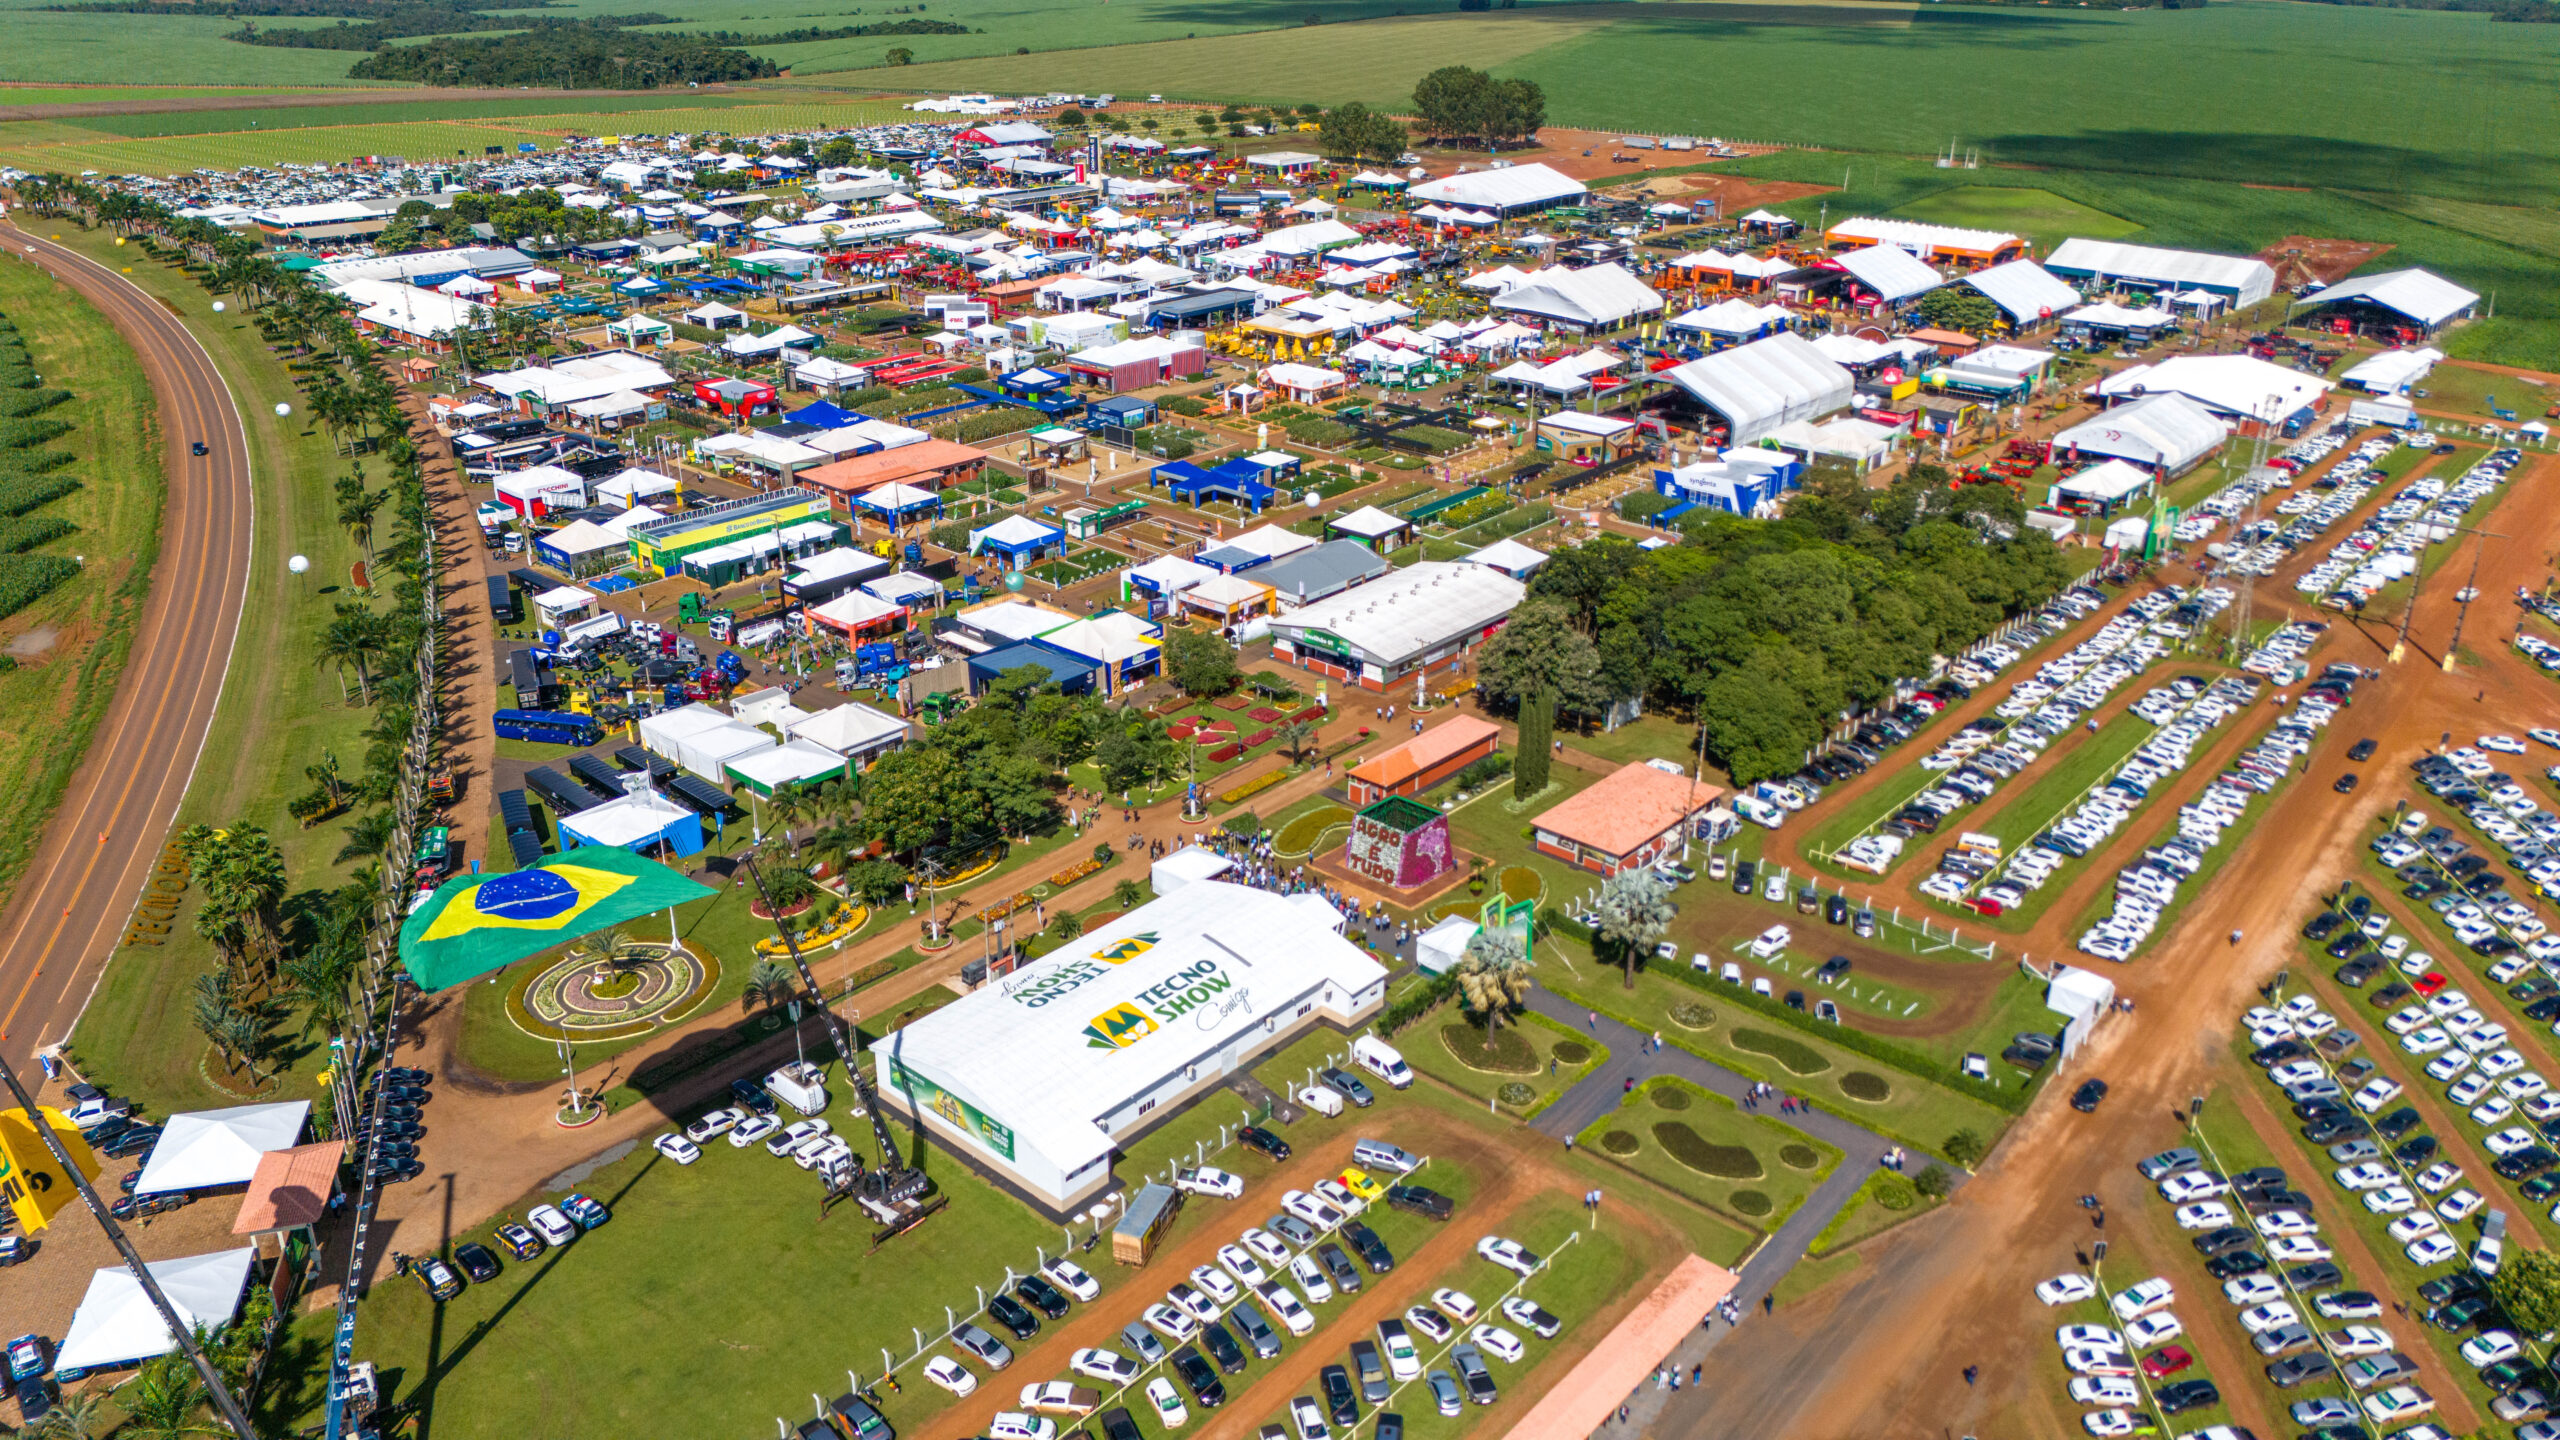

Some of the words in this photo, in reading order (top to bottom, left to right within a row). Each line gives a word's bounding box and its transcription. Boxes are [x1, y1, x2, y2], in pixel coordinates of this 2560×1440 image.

[848, 218, 901, 229] COMIGO
[1689, 477, 1717, 487] syngenta
[1356, 818, 1400, 848] AGRO
[1368, 840, 1382, 862] É
[1350, 853, 1395, 884] TUDO
[1012, 960, 1094, 1004] SHOW
[1026, 966, 1112, 1008] TECNO
[1134, 959, 1217, 1006] TECNO
[1153, 970, 1232, 1024] SHOW
[1196, 986, 1253, 1031] Comigo
[830, 1026, 861, 1082] CESAR
[365, 1117, 384, 1191] CESAR
[891, 1181, 925, 1202] CESAR
[347, 1222, 369, 1304] CESAR
